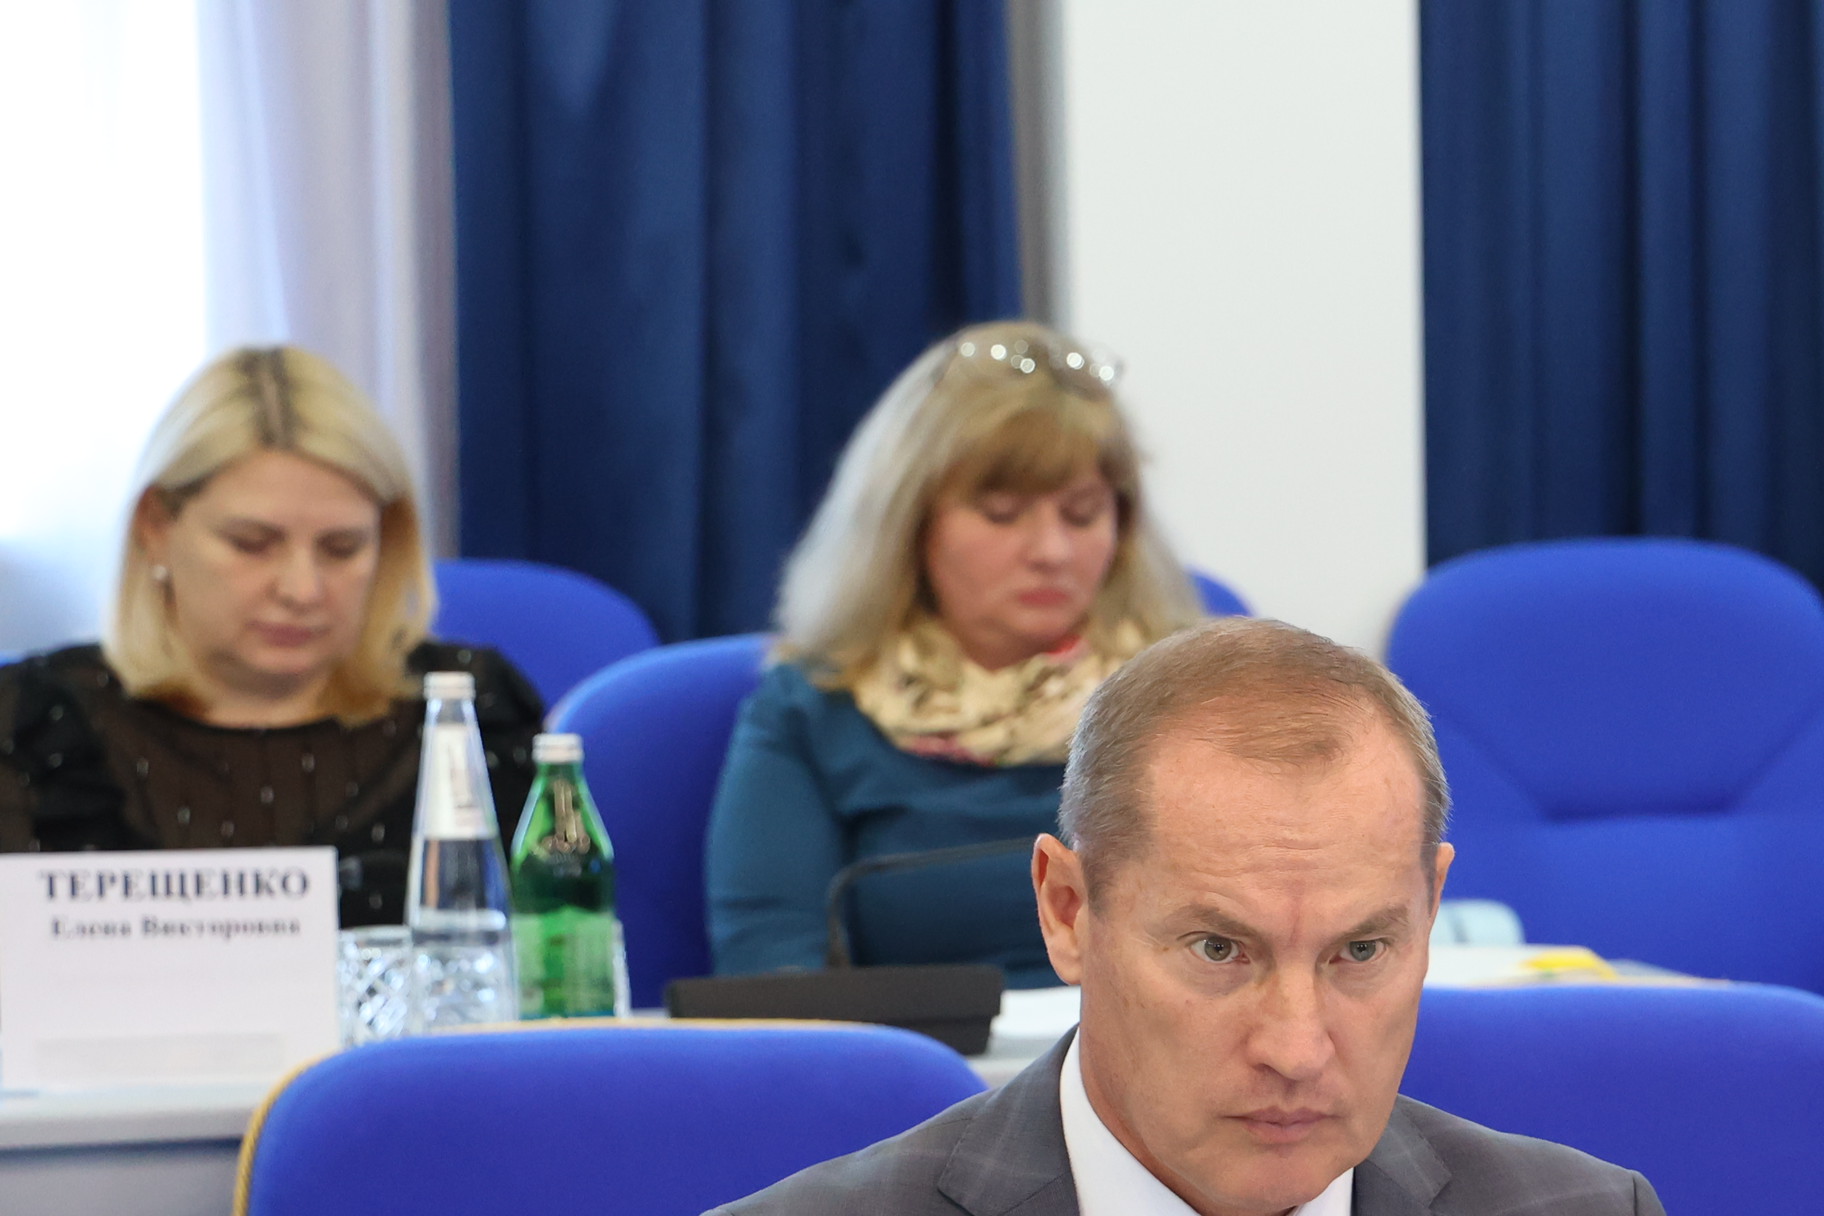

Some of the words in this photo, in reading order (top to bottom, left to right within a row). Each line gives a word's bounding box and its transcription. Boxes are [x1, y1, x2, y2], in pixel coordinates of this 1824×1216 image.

[39, 868, 310, 904] ТЕРЕЩЕНКО
[50, 915, 132, 939] Елена
[140, 914, 302, 942] Викторовна
